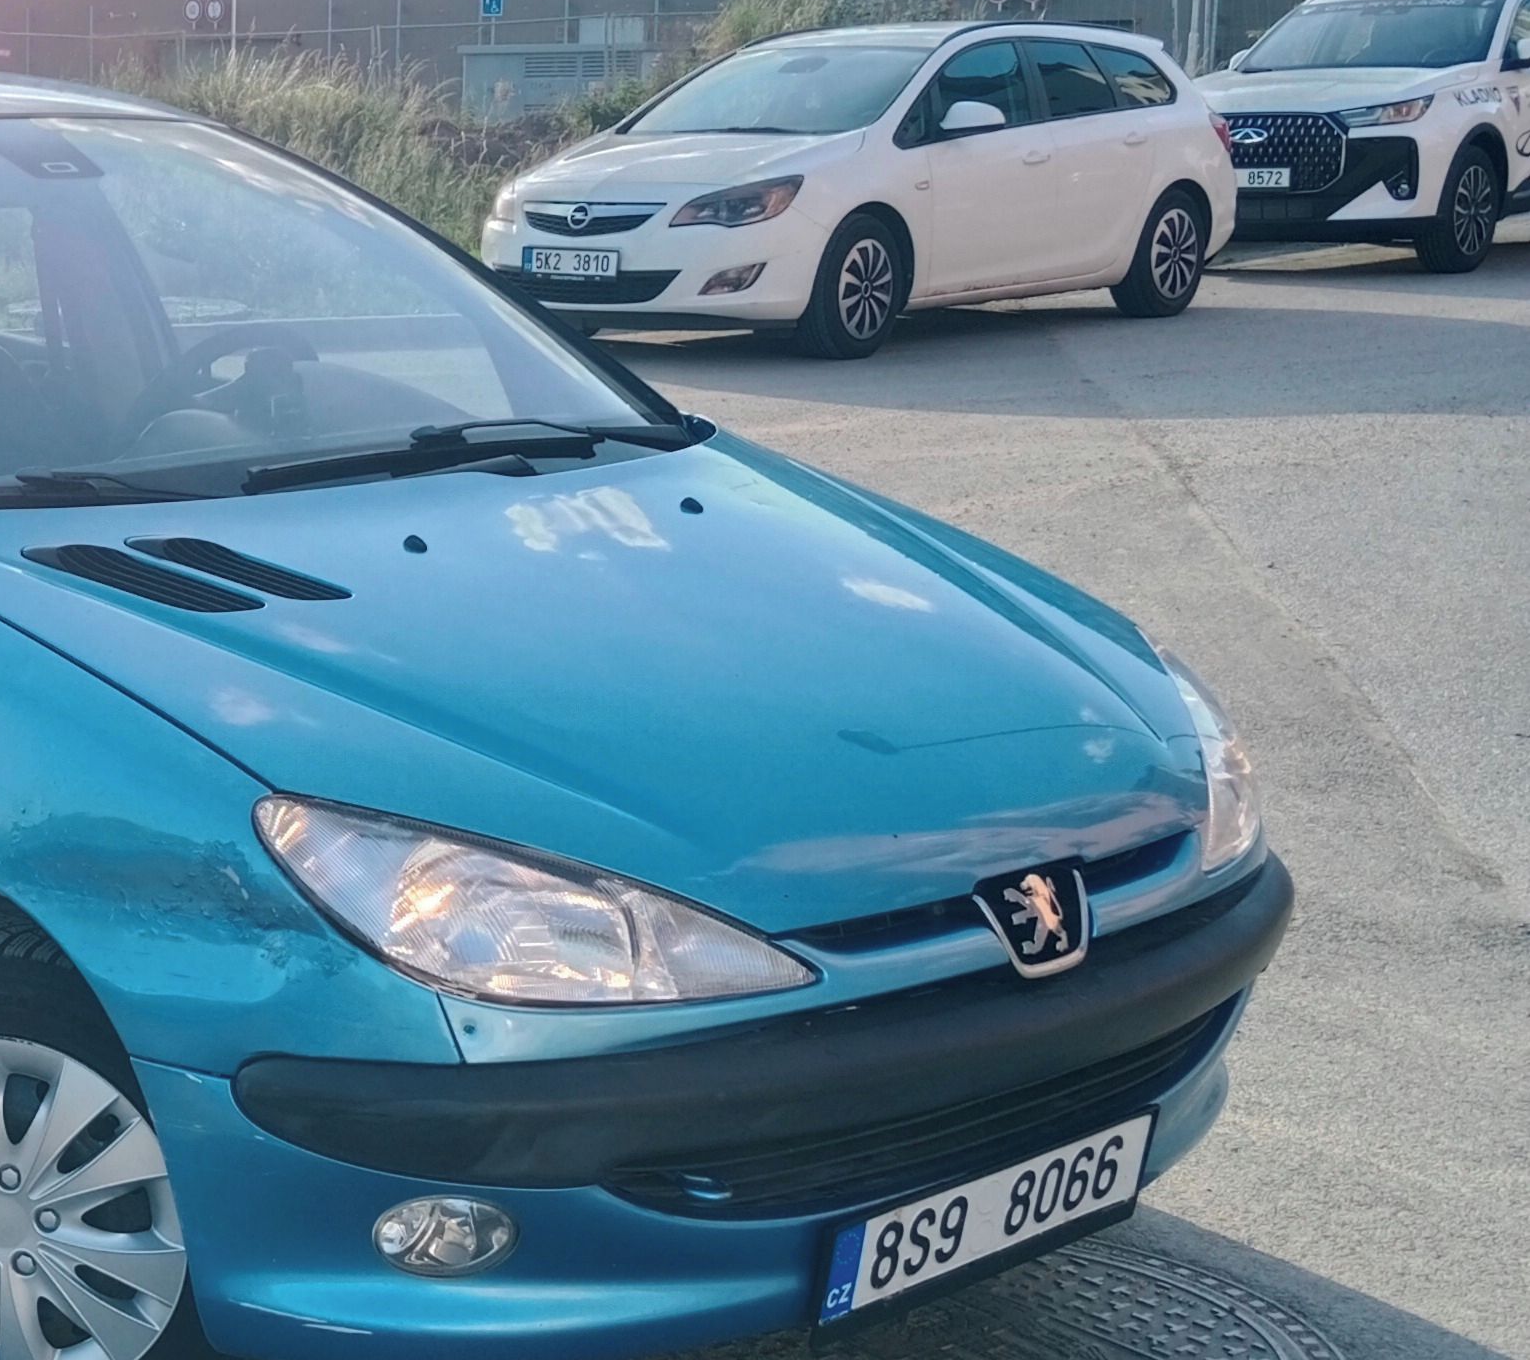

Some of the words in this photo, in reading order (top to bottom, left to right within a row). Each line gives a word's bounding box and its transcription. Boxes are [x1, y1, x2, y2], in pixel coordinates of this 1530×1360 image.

[1247, 170, 1283, 186] 8572
[535, 251, 562, 271] 5K2
[573, 253, 610, 273] 3810
[870, 1195, 969, 1290] 8S9
[1003, 1135, 1124, 1236] 8066
[826, 1281, 852, 1309] CZ
